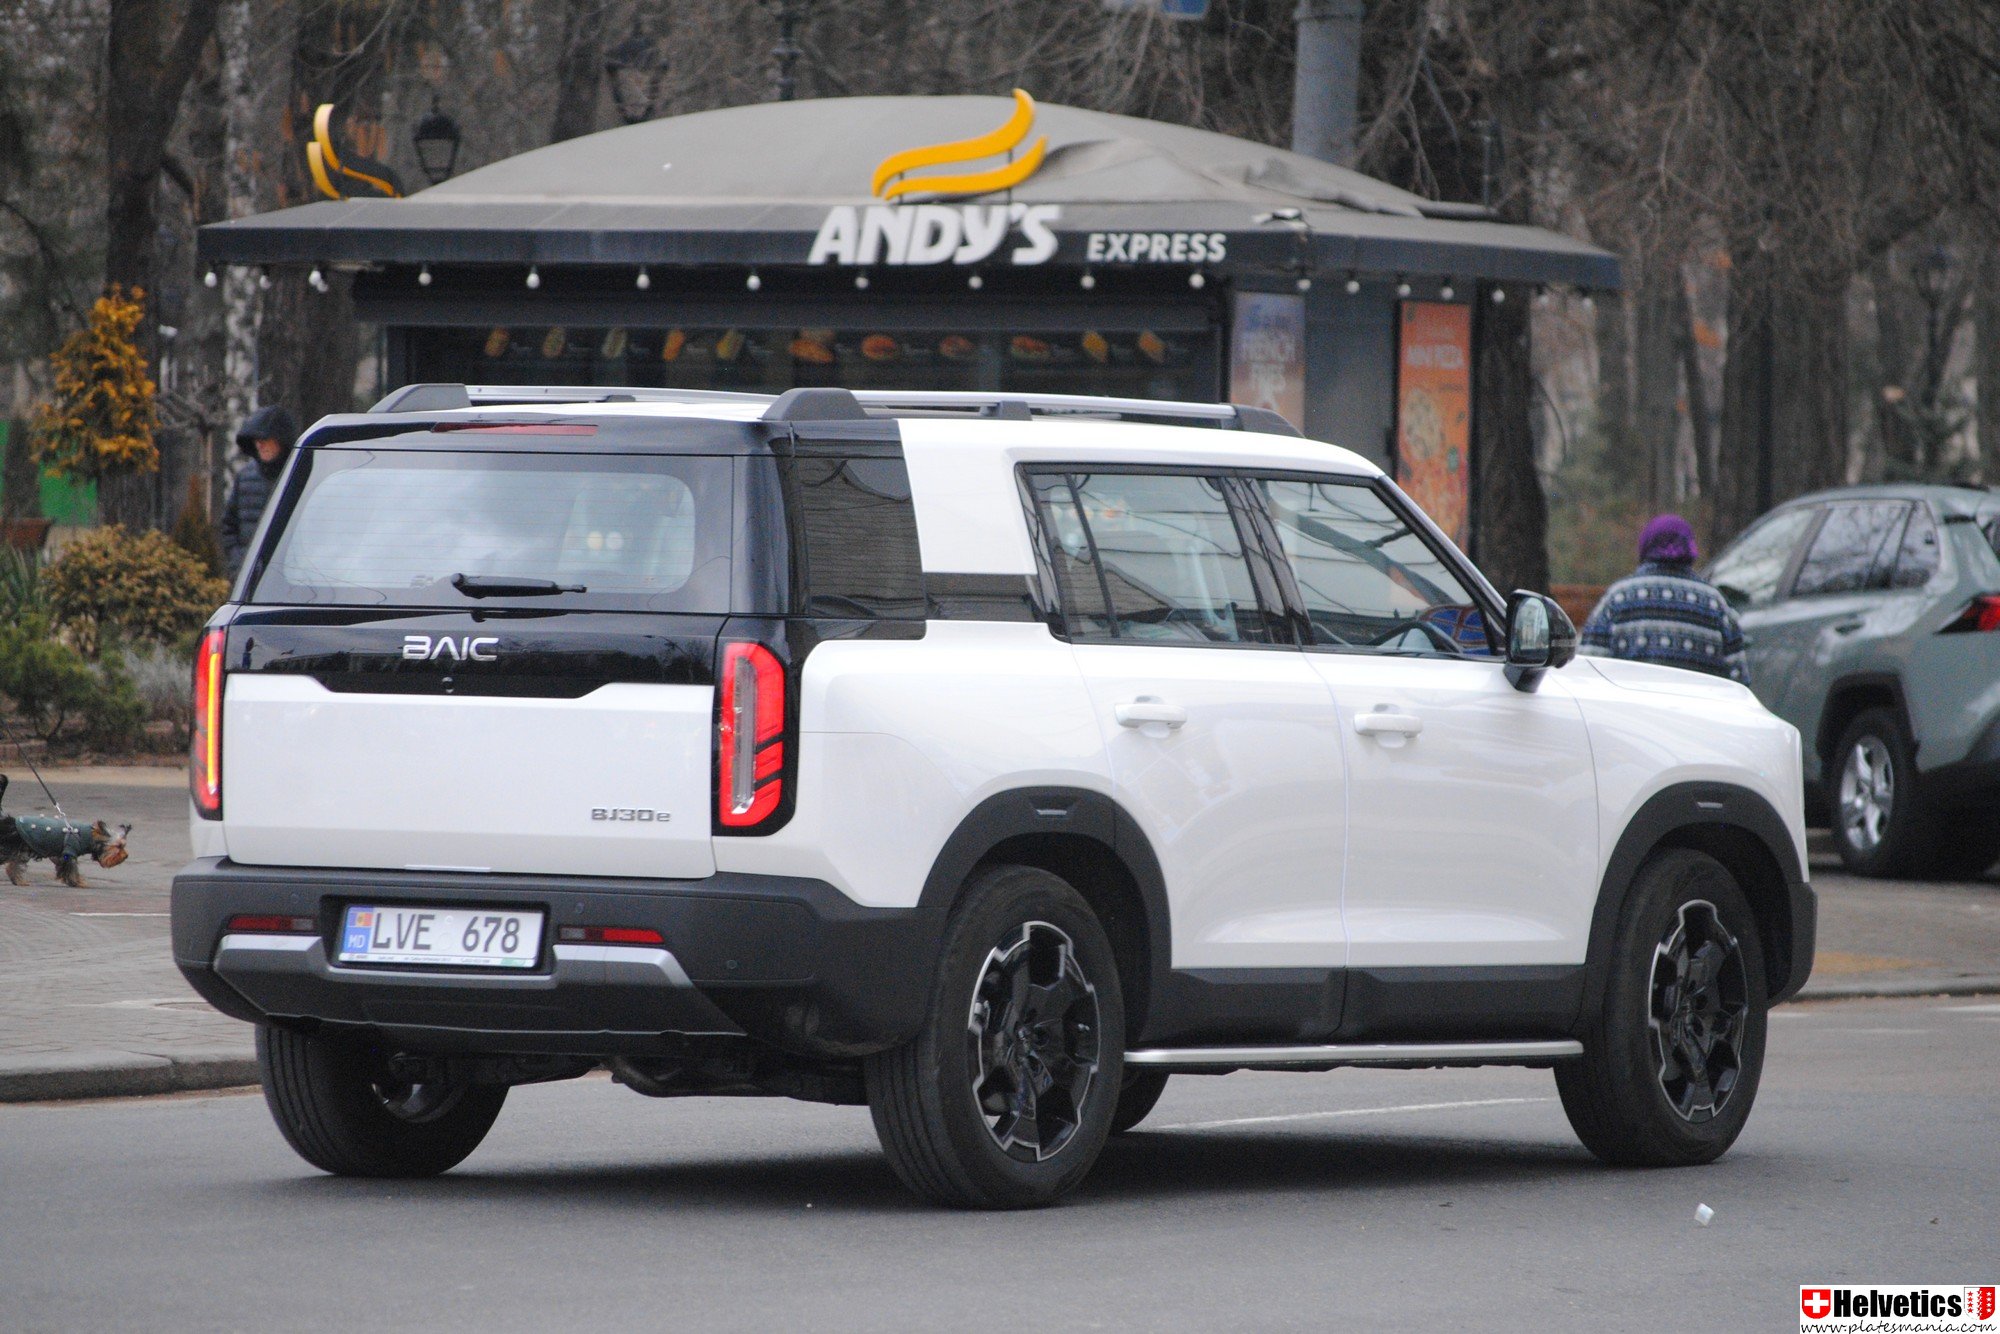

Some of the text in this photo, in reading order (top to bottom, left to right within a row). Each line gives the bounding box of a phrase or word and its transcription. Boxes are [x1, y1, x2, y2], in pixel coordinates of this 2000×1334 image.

[807, 203, 1227, 265] ANDY'S EXPRESS
[402, 635, 499, 661] BAIC
[591, 807, 671, 822] BJ30e
[347, 934, 365, 949] MD
[372, 912, 520, 953] LVE 678
